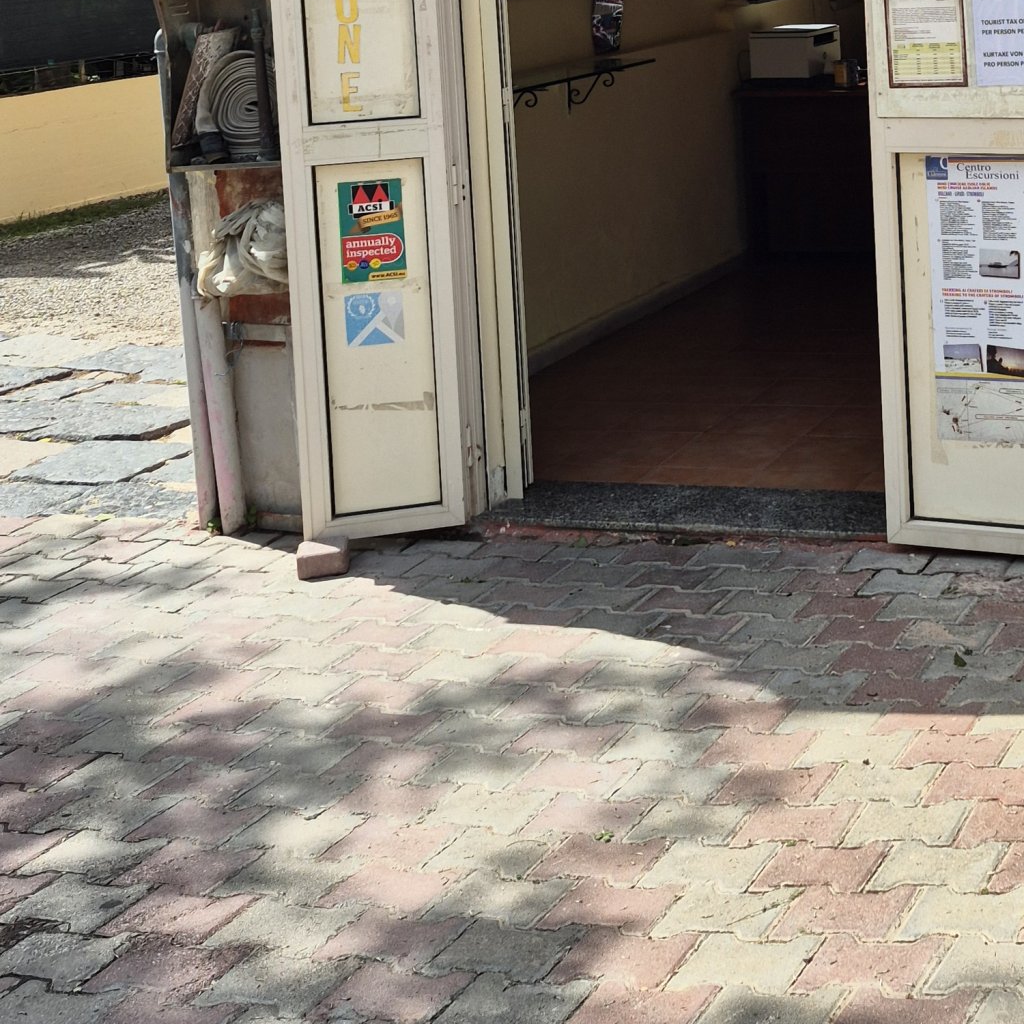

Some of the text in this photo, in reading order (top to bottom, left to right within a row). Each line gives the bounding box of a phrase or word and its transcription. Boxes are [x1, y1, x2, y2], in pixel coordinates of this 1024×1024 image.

[956, 162, 992, 172] Centro
[965, 170, 1019, 180] Escursioni
[362, 216, 382, 225] SINCE
[346, 235, 396, 249] annually
[346, 246, 397, 258] inspected
